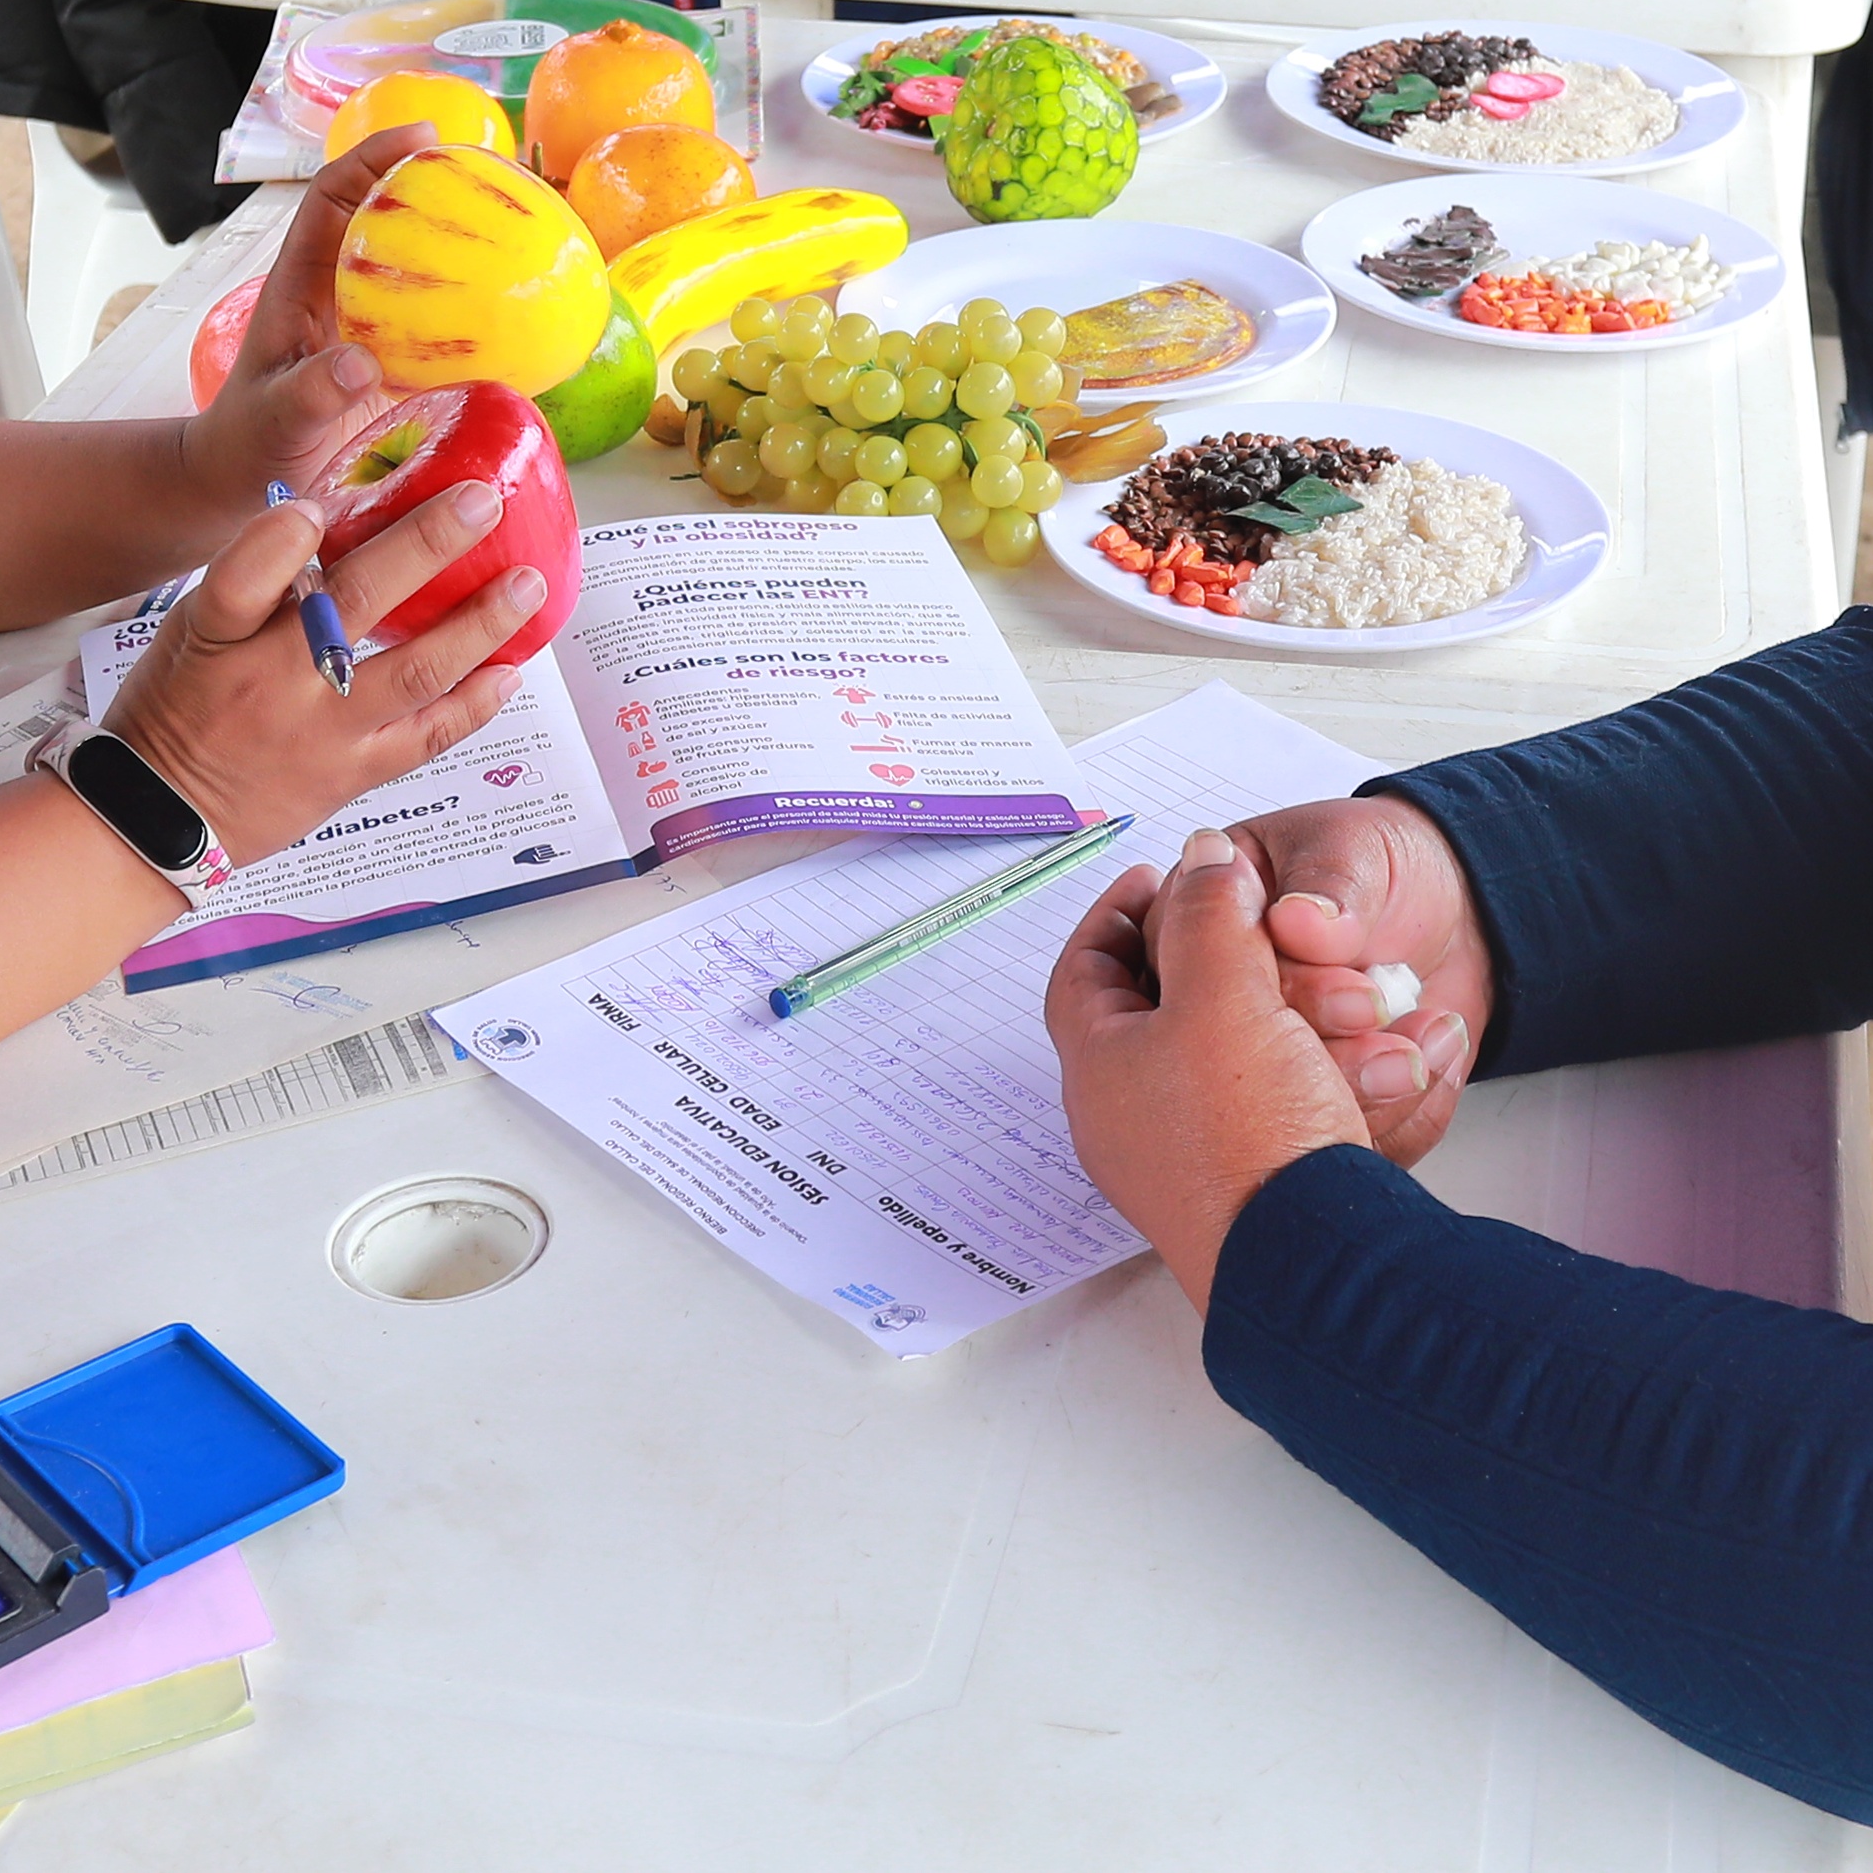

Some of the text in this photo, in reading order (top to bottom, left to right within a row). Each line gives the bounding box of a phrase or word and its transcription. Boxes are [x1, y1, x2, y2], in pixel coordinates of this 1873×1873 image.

[583, 519, 858, 546] ¿Qué es el sobrepeso
[630, 530, 819, 549] y la obesidad?
[609, 552, 671, 567] consisten
[783, 550, 814, 558] peso
[817, 550, 869, 558] corporal
[632, 578, 866, 600] ¿Quiénes pueden
[637, 589, 869, 612] padecer las ENT?
[622, 651, 949, 685] ¿Cuáles son los factores
[726, 666, 867, 680] de riesgo?
[652, 686, 750, 707] Antecedentes
[655, 691, 821, 715] familiares: hipertensión,
[883, 693, 925, 701] Estrés
[939, 694, 999, 702] ansiedad
[658, 704, 714, 721] diabetes
[734, 698, 798, 708] obesidad
[893, 711, 1012, 720] Falta de actividad
[661, 713, 752, 733] Uso excesivo
[665, 721, 768, 743] de sal y azúcar
[897, 719, 933, 727] física
[453, 731, 549, 759] ser menor de
[671, 735, 773, 758] Bajo consumo
[675, 742, 815, 765] de frutas y verduras
[911, 738, 956, 747] Fumar
[681, 760, 750, 778] Consumo
[685, 768, 768, 788] excesivo de
[920, 767, 989, 776] Colesterol
[689, 782, 743, 799] alcohol
[1010, 778, 1045, 786] altos
[774, 797, 895, 808] Recuerda:
[316, 795, 460, 841] diabetes?
[246, 792, 569, 879] por la elevación anormal de los niveles de
[228, 802, 573, 893] la sangre, debido a un defecto en la producción
[178, 844, 508, 926] células que facilitan la producción de energía.
[587, 992, 641, 1031] FIRMA
[653, 1040, 728, 1093] CELULAR
[728, 1096, 782, 1131] EDAD
[674, 1095, 829, 1205] SESION EDUCATIVA
[805, 1149, 847, 1175] DNI
[604, 1139, 727, 1234] BIERNO REGIONAL DEL CALLAO
[609, 1120, 766, 1237] DIRECCION REGIONAL DE SALUD DEL CALLAO
[878, 1195, 1035, 1294] Nombre y apellido
